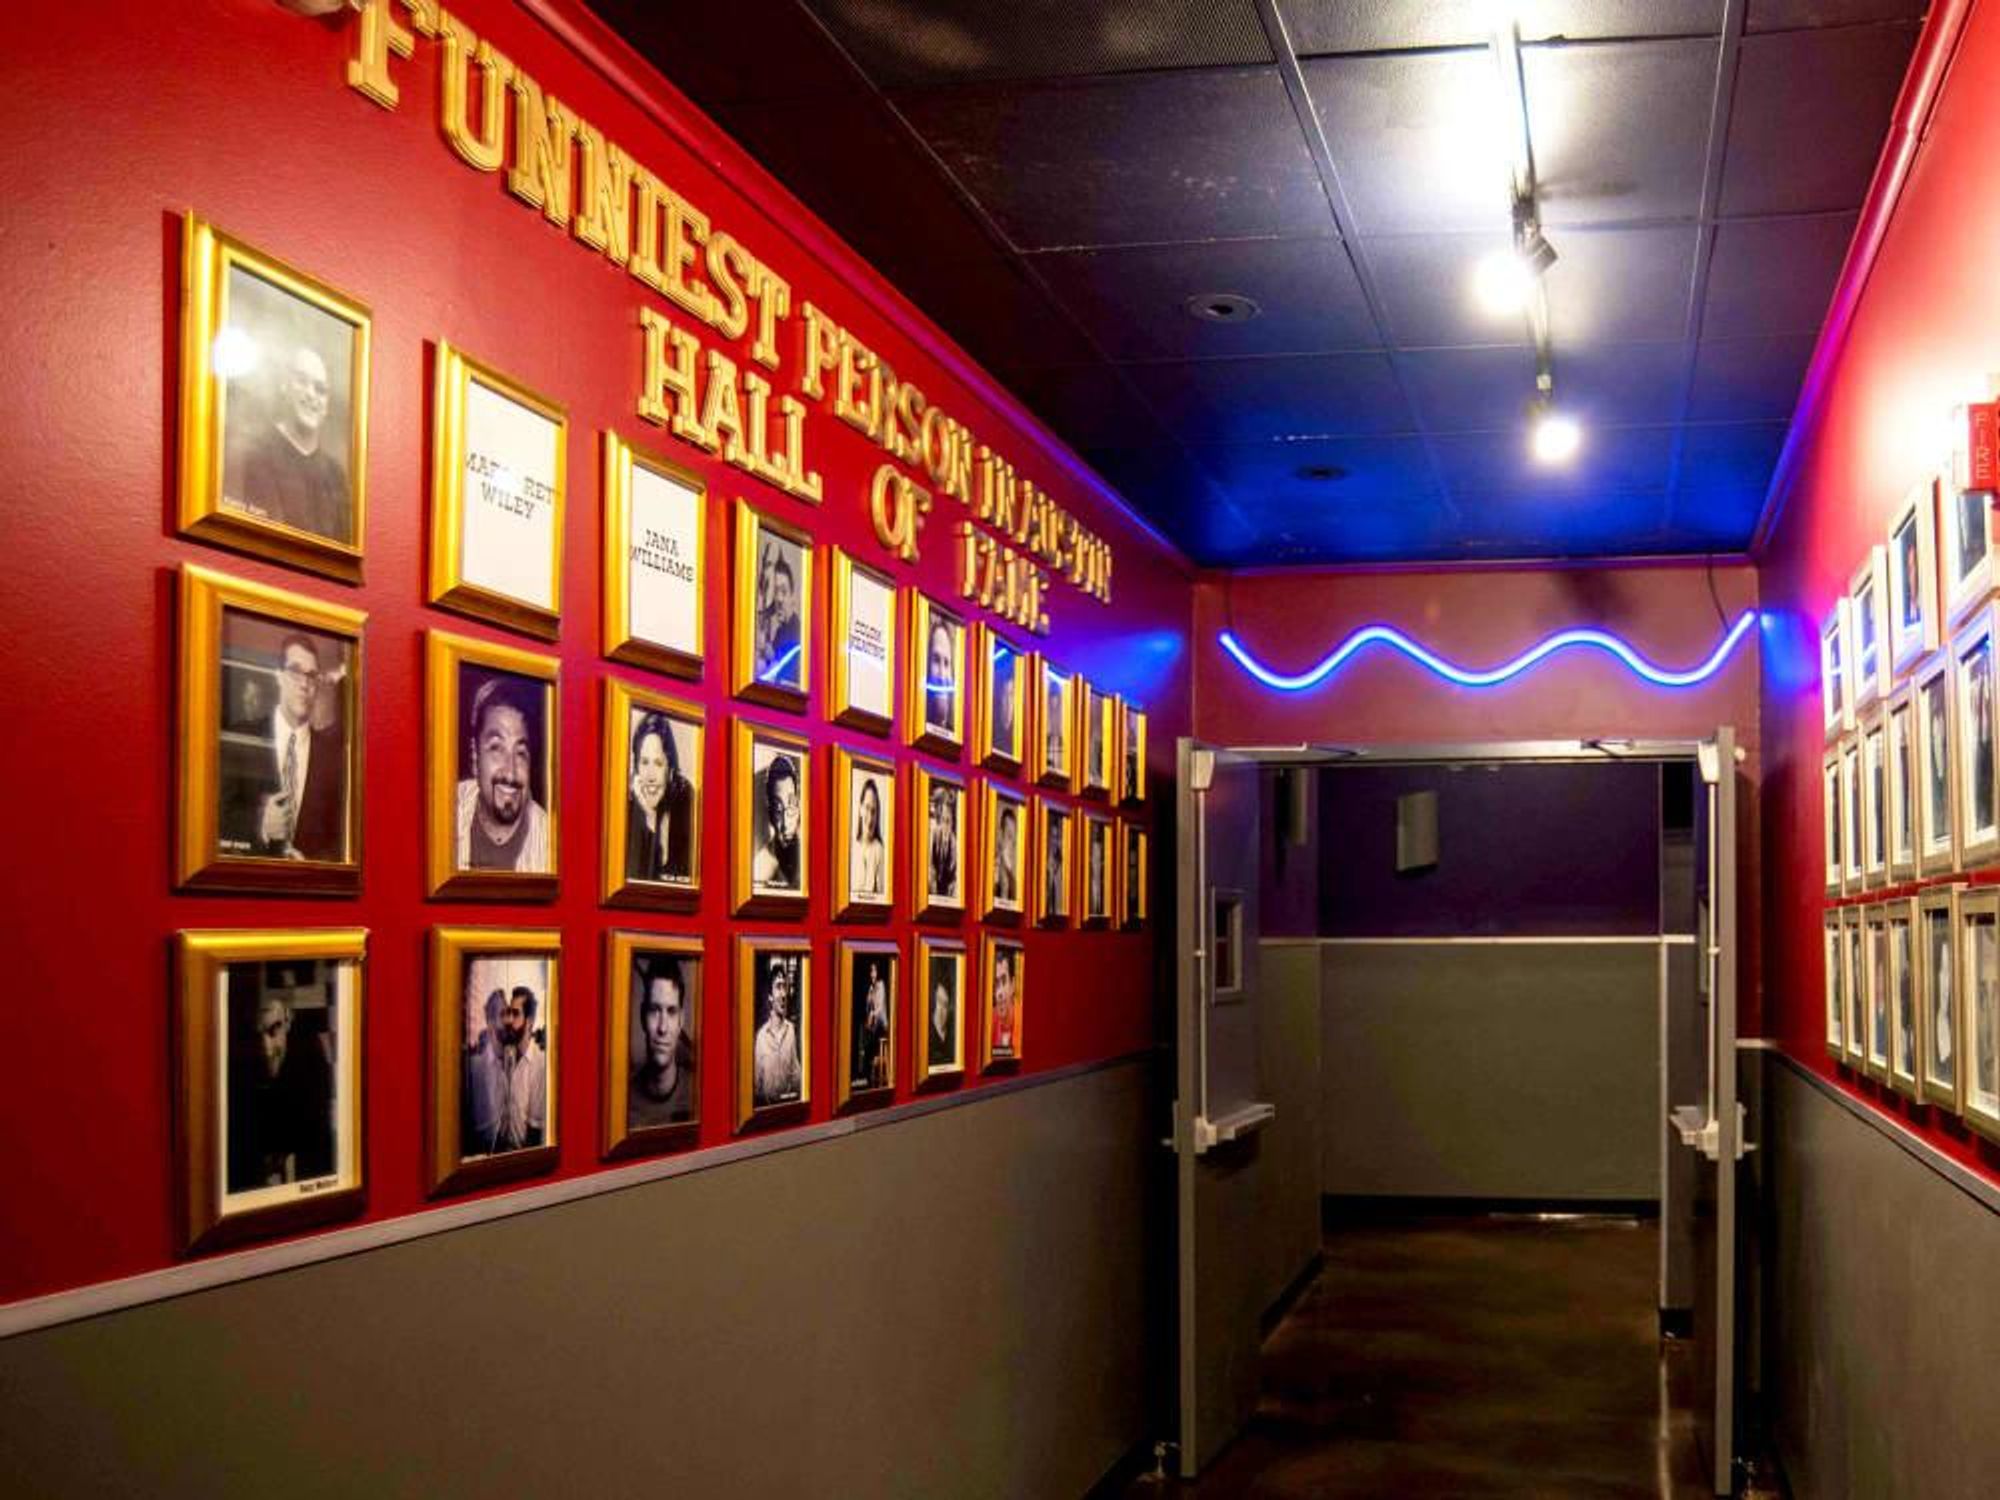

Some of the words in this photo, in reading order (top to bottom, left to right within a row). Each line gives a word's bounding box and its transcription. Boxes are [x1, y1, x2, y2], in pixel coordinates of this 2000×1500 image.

[347, 0, 790, 370] FUNNIEST
[803, 301, 973, 504] PERSON
[979, 445, 1016, 535] IN
[637, 306, 823, 503] HALL
[872, 464, 932, 562] OF
[962, 520, 1050, 636] FAME
[1975, 411, 1991, 480] FIRE
[481, 481, 535, 519] WILEY
[631, 545, 693, 583] WILLIAMS
